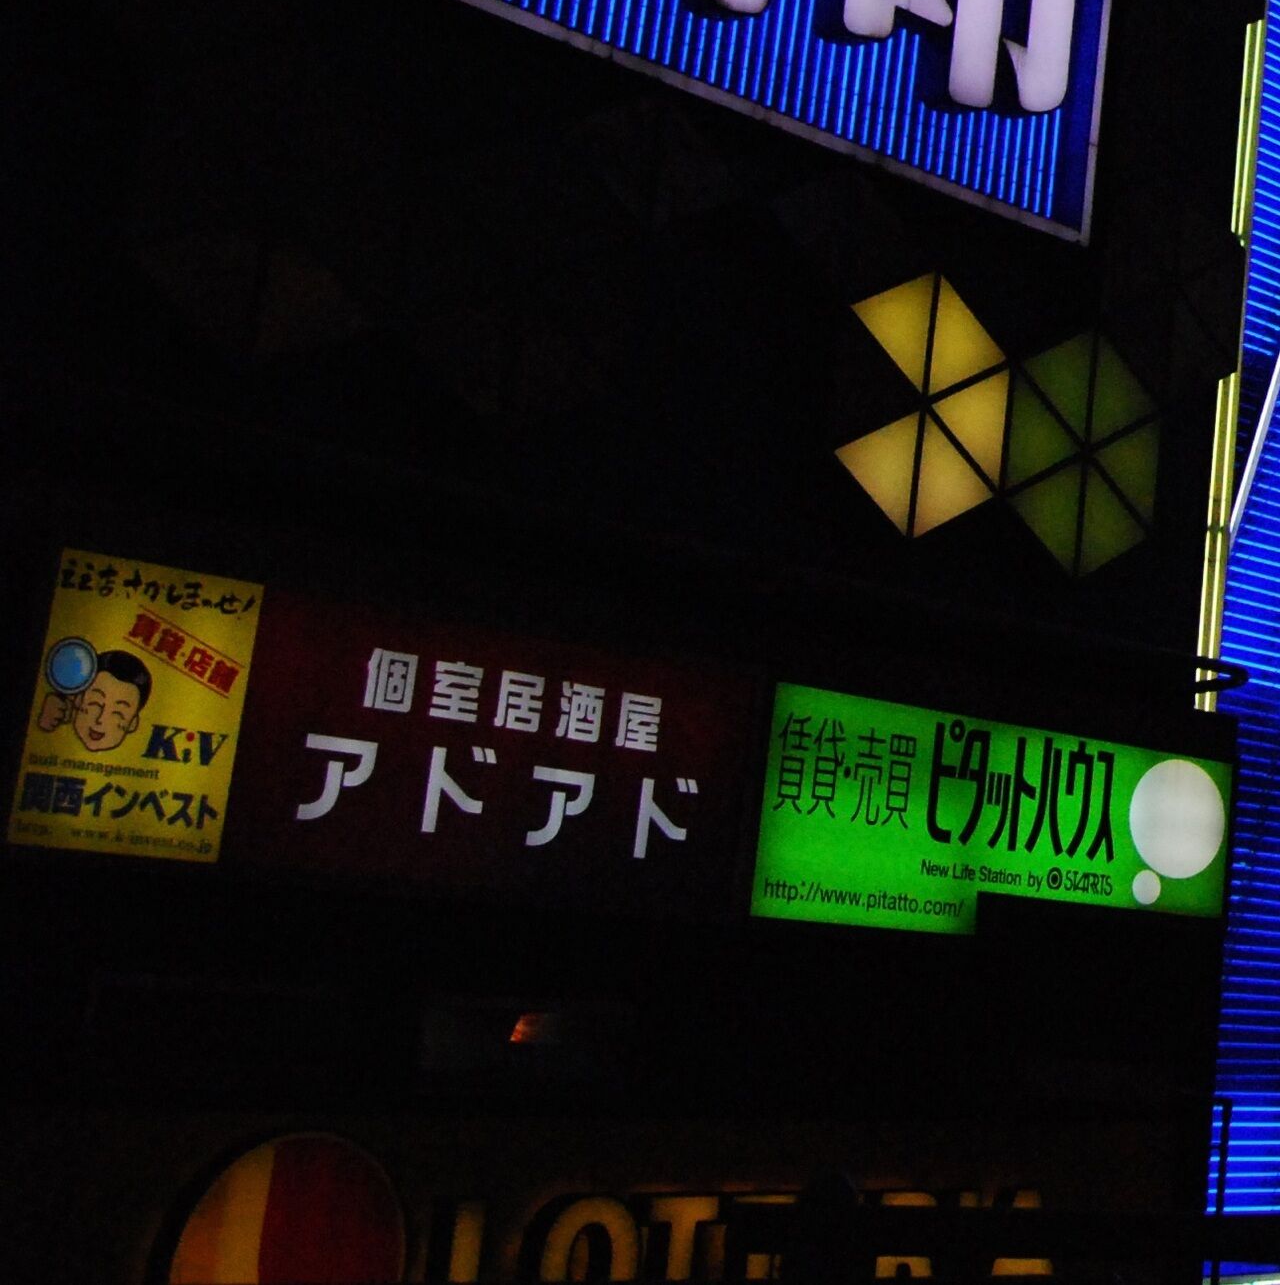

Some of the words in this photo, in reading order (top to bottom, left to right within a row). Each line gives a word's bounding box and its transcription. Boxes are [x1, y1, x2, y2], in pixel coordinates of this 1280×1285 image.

[364, 647, 663, 753] 個室居酒屋
[19, 772, 220, 830] 関西インベスト
[297, 733, 703, 860] アドアド
[772, 712, 918, 830] 賃貸・売買
[927, 719, 1116, 864] ピタットハウス
[763, 876, 966, 918] http://www.pitatto.com/
[920, 859, 949, 879] New
[952, 862, 977, 883] Life
[979, 863, 1022, 887] Station
[1027, 868, 1044, 891] by
